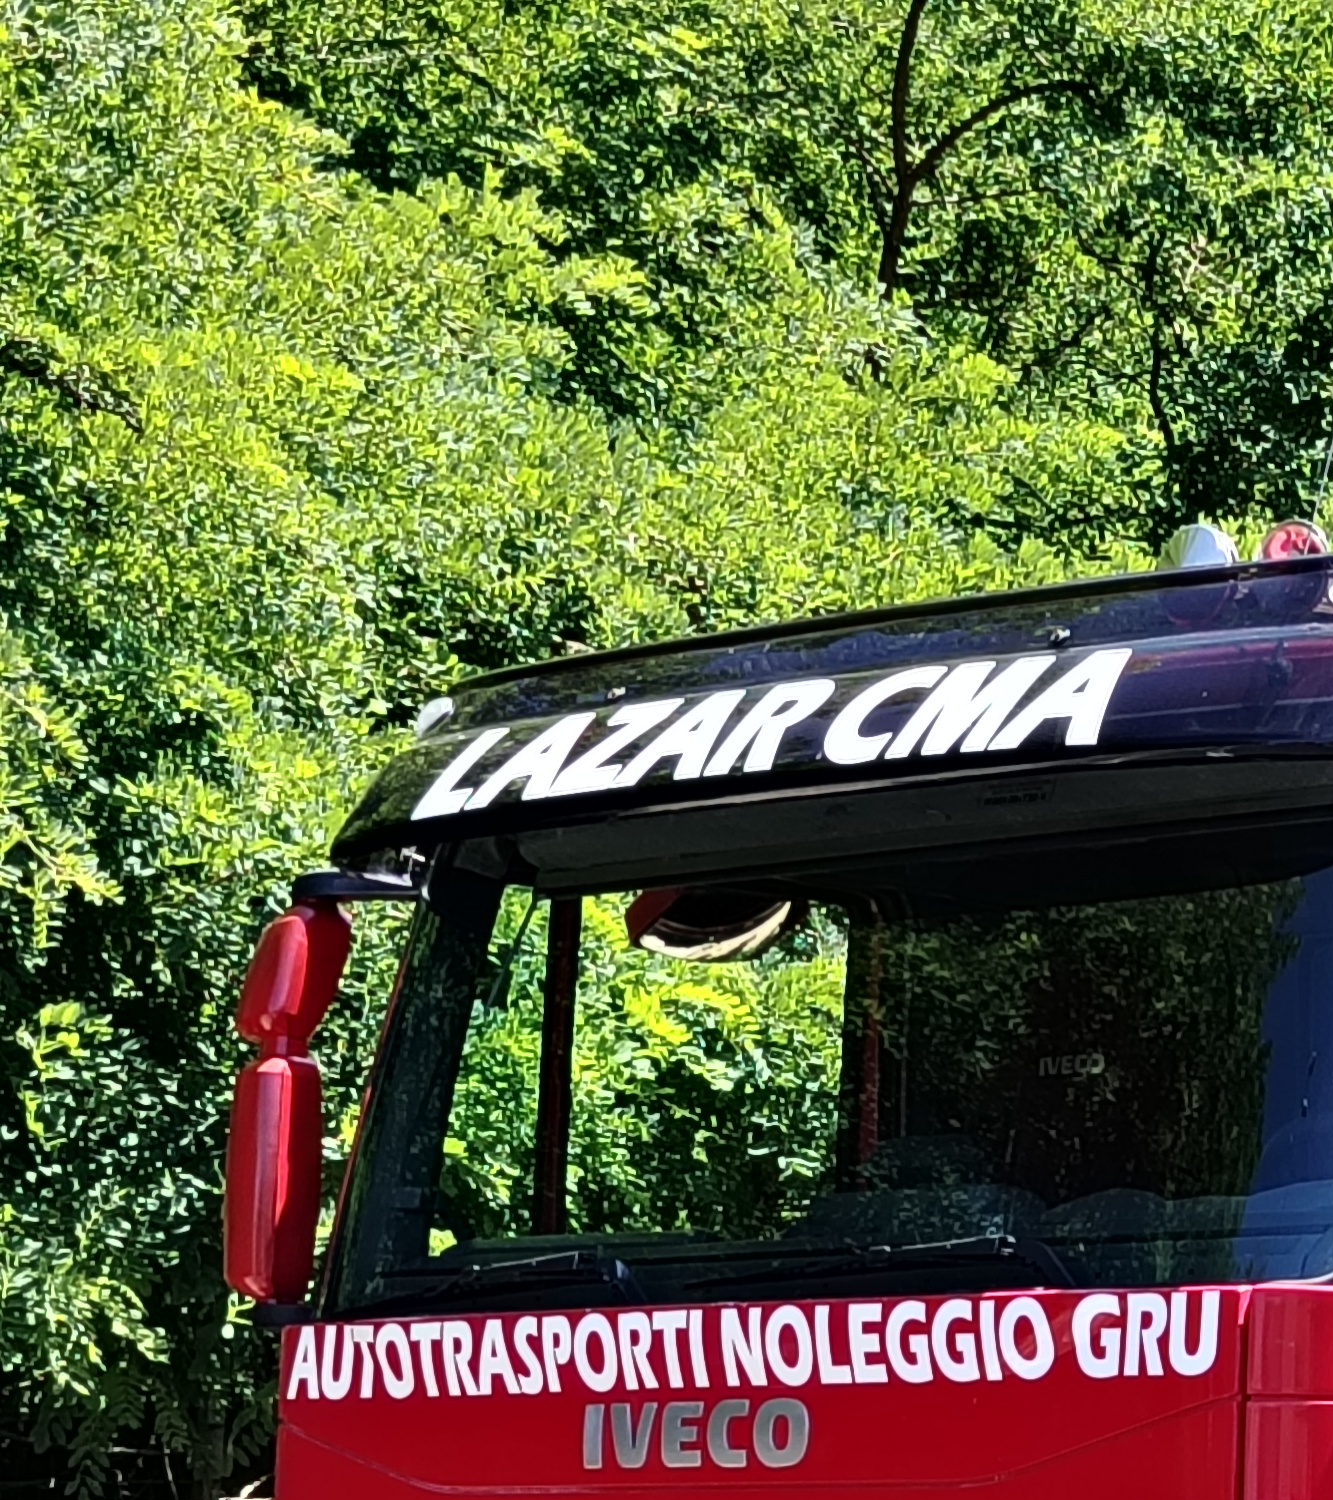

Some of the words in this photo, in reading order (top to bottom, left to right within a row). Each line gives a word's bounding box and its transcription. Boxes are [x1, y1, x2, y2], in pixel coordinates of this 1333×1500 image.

[411, 678, 836, 821] LAZAR
[823, 647, 1133, 765] CMA
[287, 1309, 707, 1400] AUTOTRASPORTI
[721, 1295, 1055, 1387] NOLEGGIO
[1070, 1290, 1220, 1379] GRU
[583, 1398, 811, 1469] IVECO
